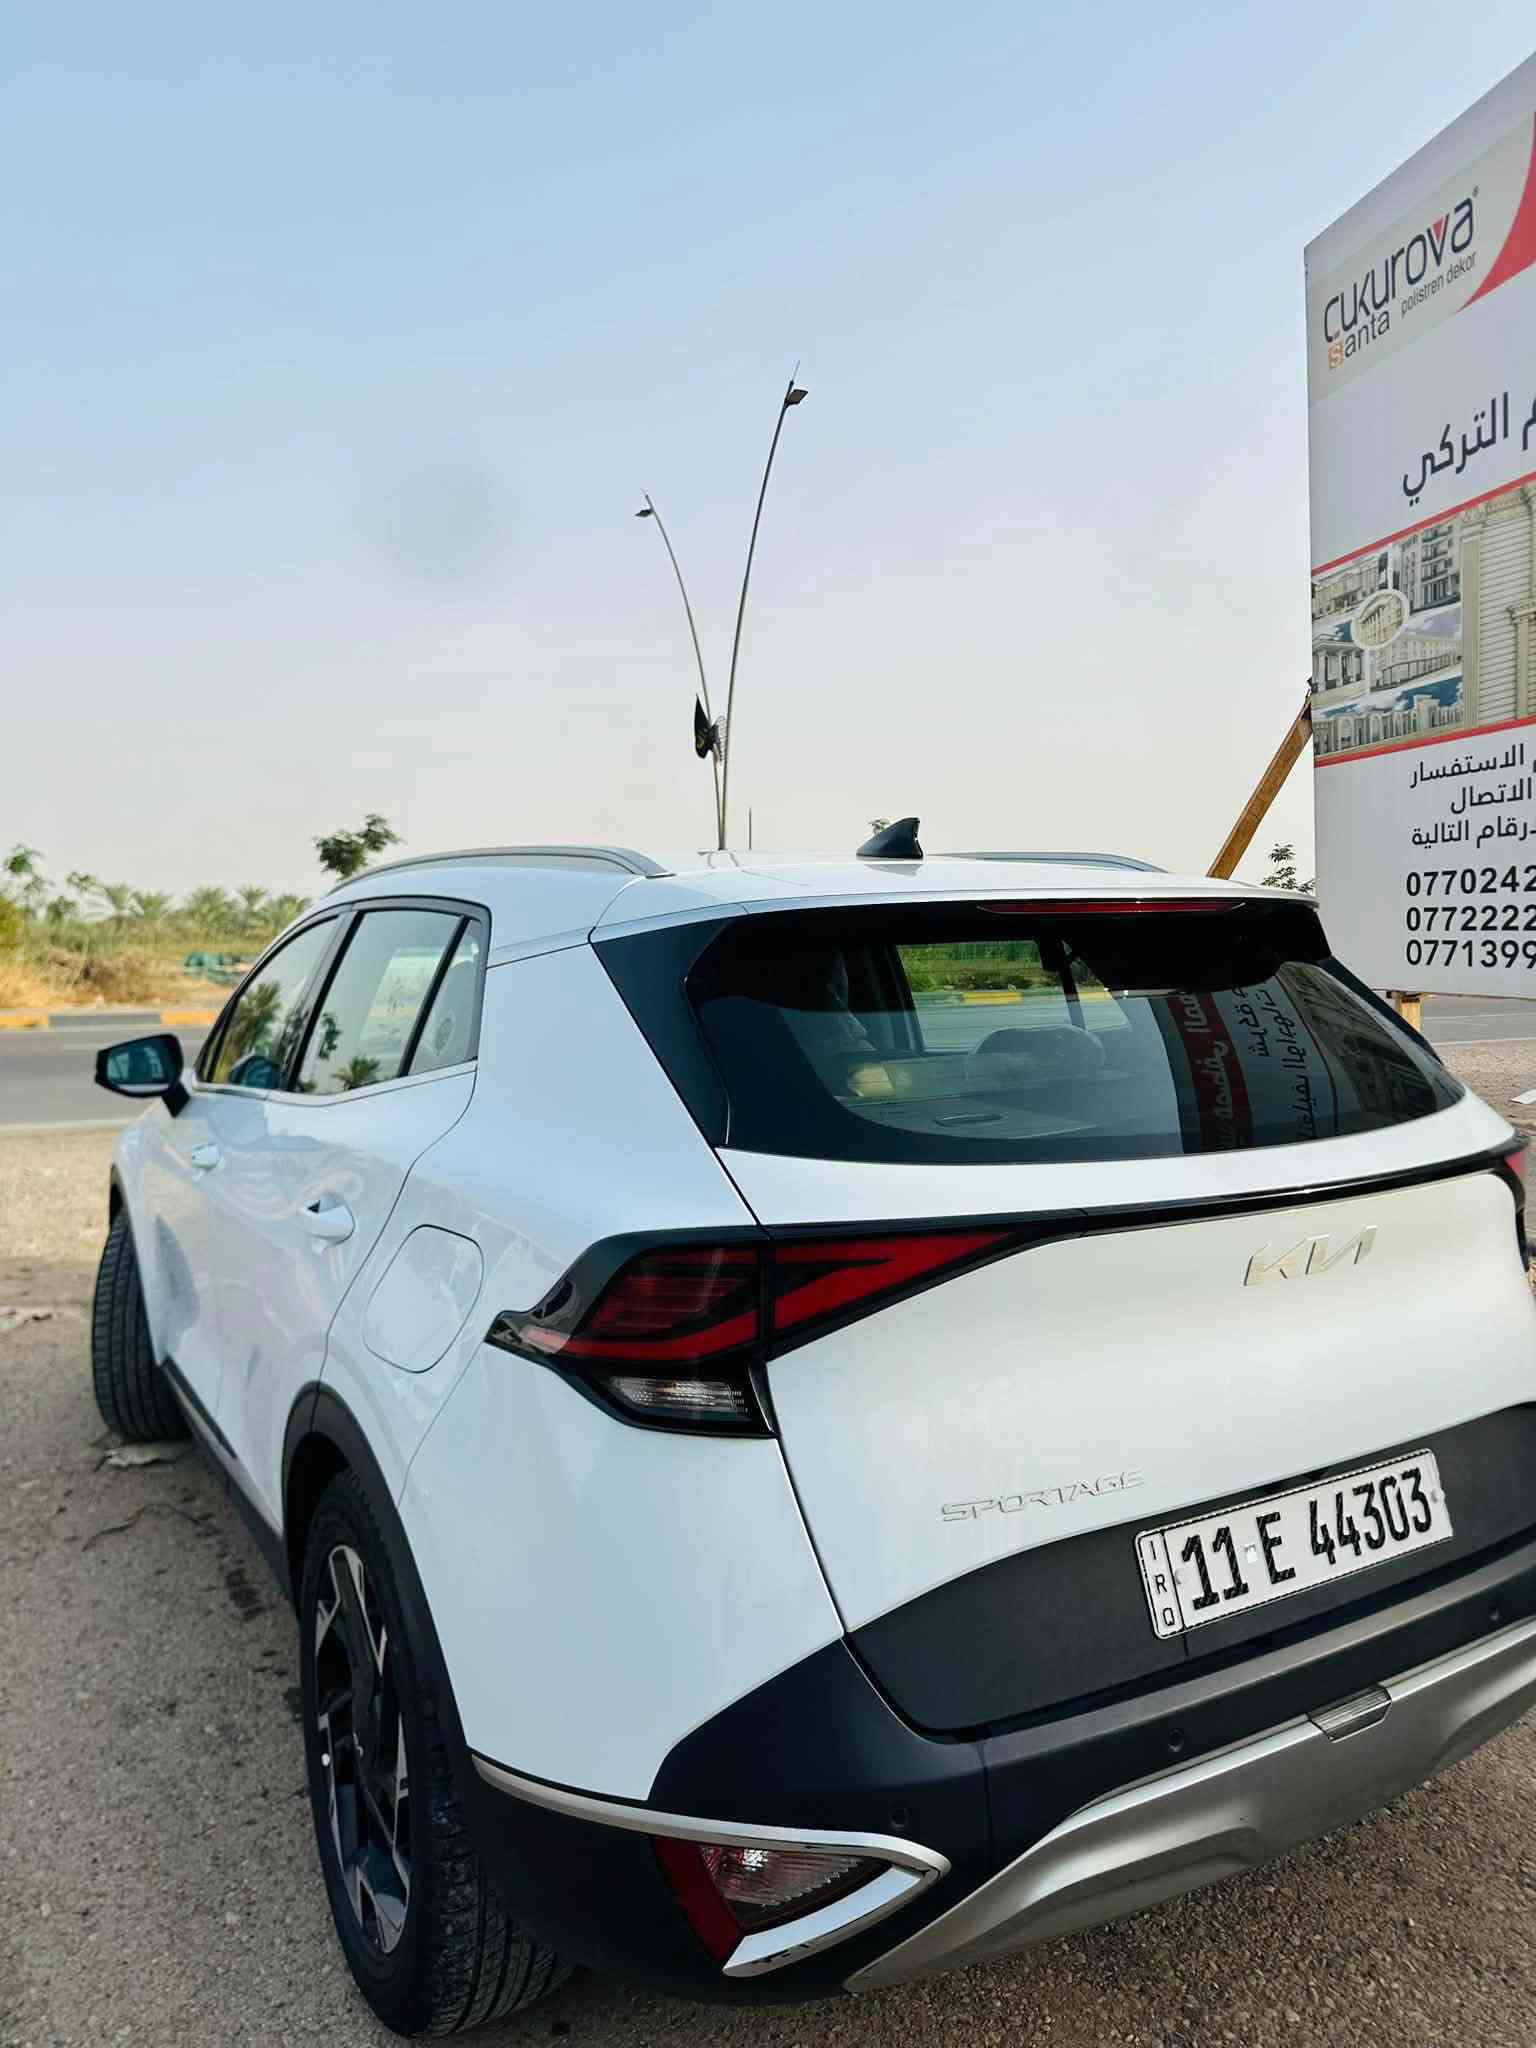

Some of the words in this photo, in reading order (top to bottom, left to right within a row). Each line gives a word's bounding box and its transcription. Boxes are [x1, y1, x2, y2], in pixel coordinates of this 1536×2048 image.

[1400, 276, 1445, 319] polistren
[1446, 252, 1477, 285] dekor
[1403, 391, 1509, 506] التركي
[1410, 743, 1524, 788] الاستفسار
[1450, 777, 1532, 814] الاتصال
[1411, 819, 1470, 850] التالية
[1406, 865, 1536, 896] 0770242
[1406, 904, 1536, 931] 0772222
[1406, 939, 1536, 969] 0771399
[941, 1468, 1146, 1522] SPORTAGE
[1181, 1526, 1251, 1611] 11
[1256, 1511, 1297, 1586] E
[1309, 1467, 1433, 1566] 44303
